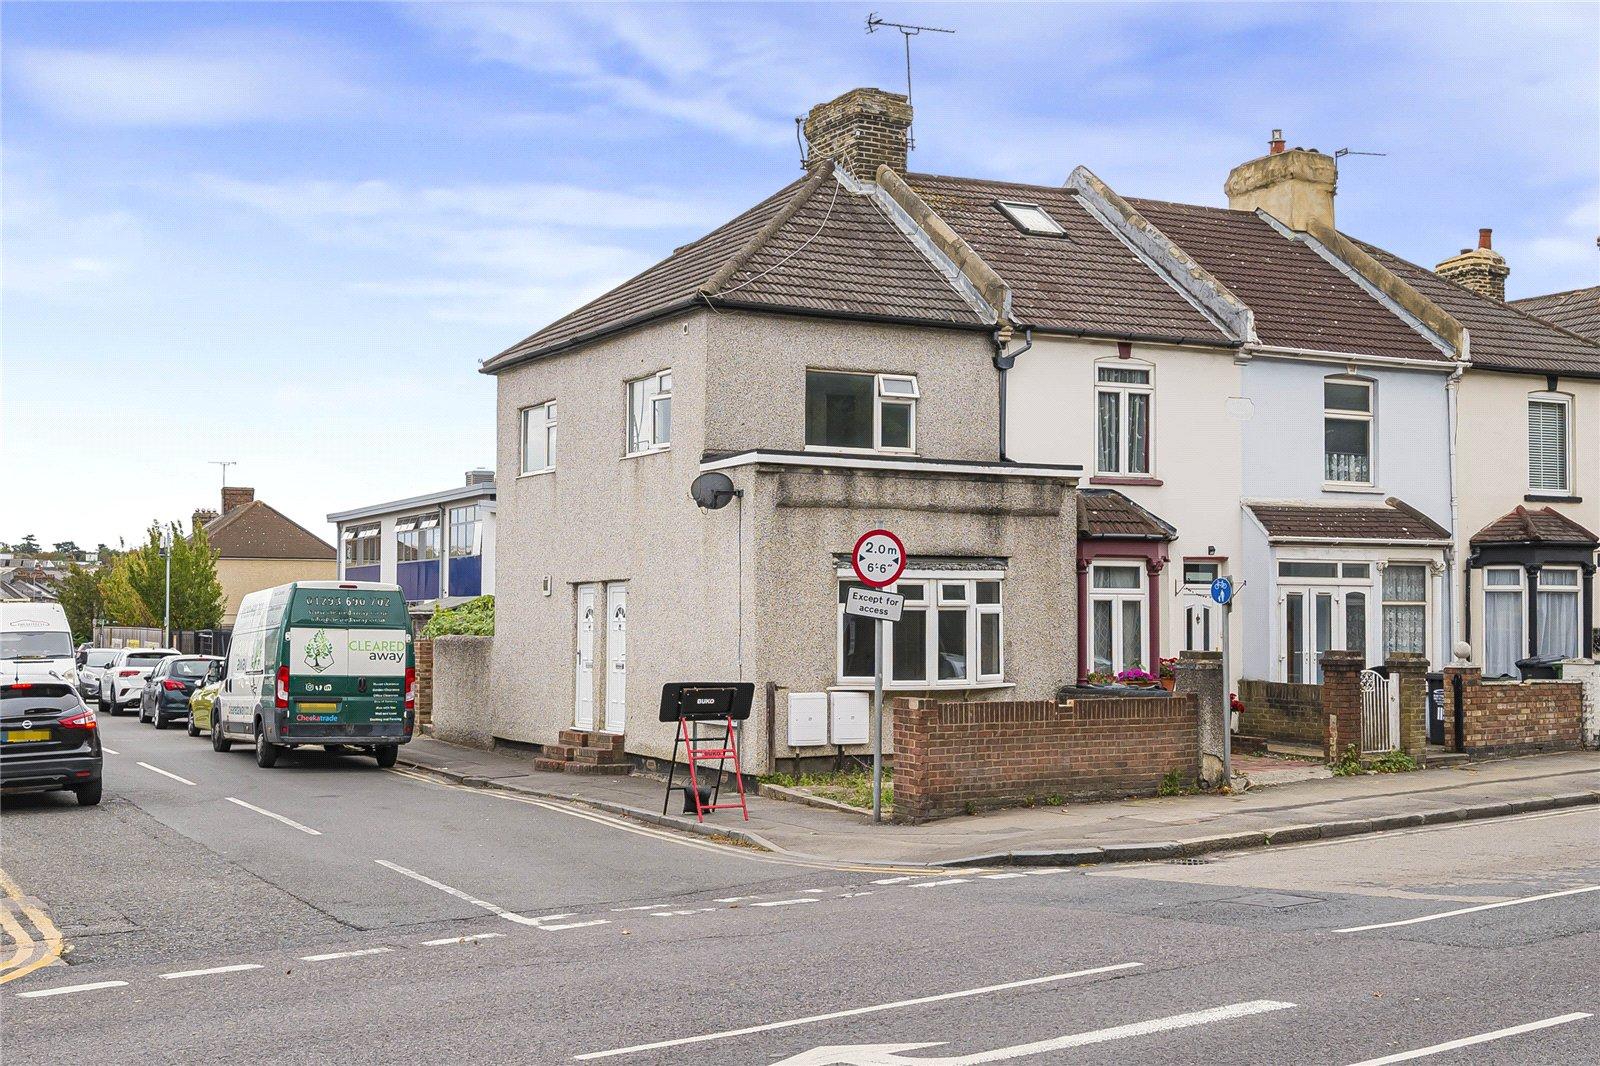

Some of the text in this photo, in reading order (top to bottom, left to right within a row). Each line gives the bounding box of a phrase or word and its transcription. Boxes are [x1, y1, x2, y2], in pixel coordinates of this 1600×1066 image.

[306, 596, 342, 606] 01293
[345, 596, 366, 607] 690
[852, 591, 899, 607] Except for
[858, 605, 889, 616] access
[348, 640, 405, 652] CLEARED
[369, 652, 405, 664] away
